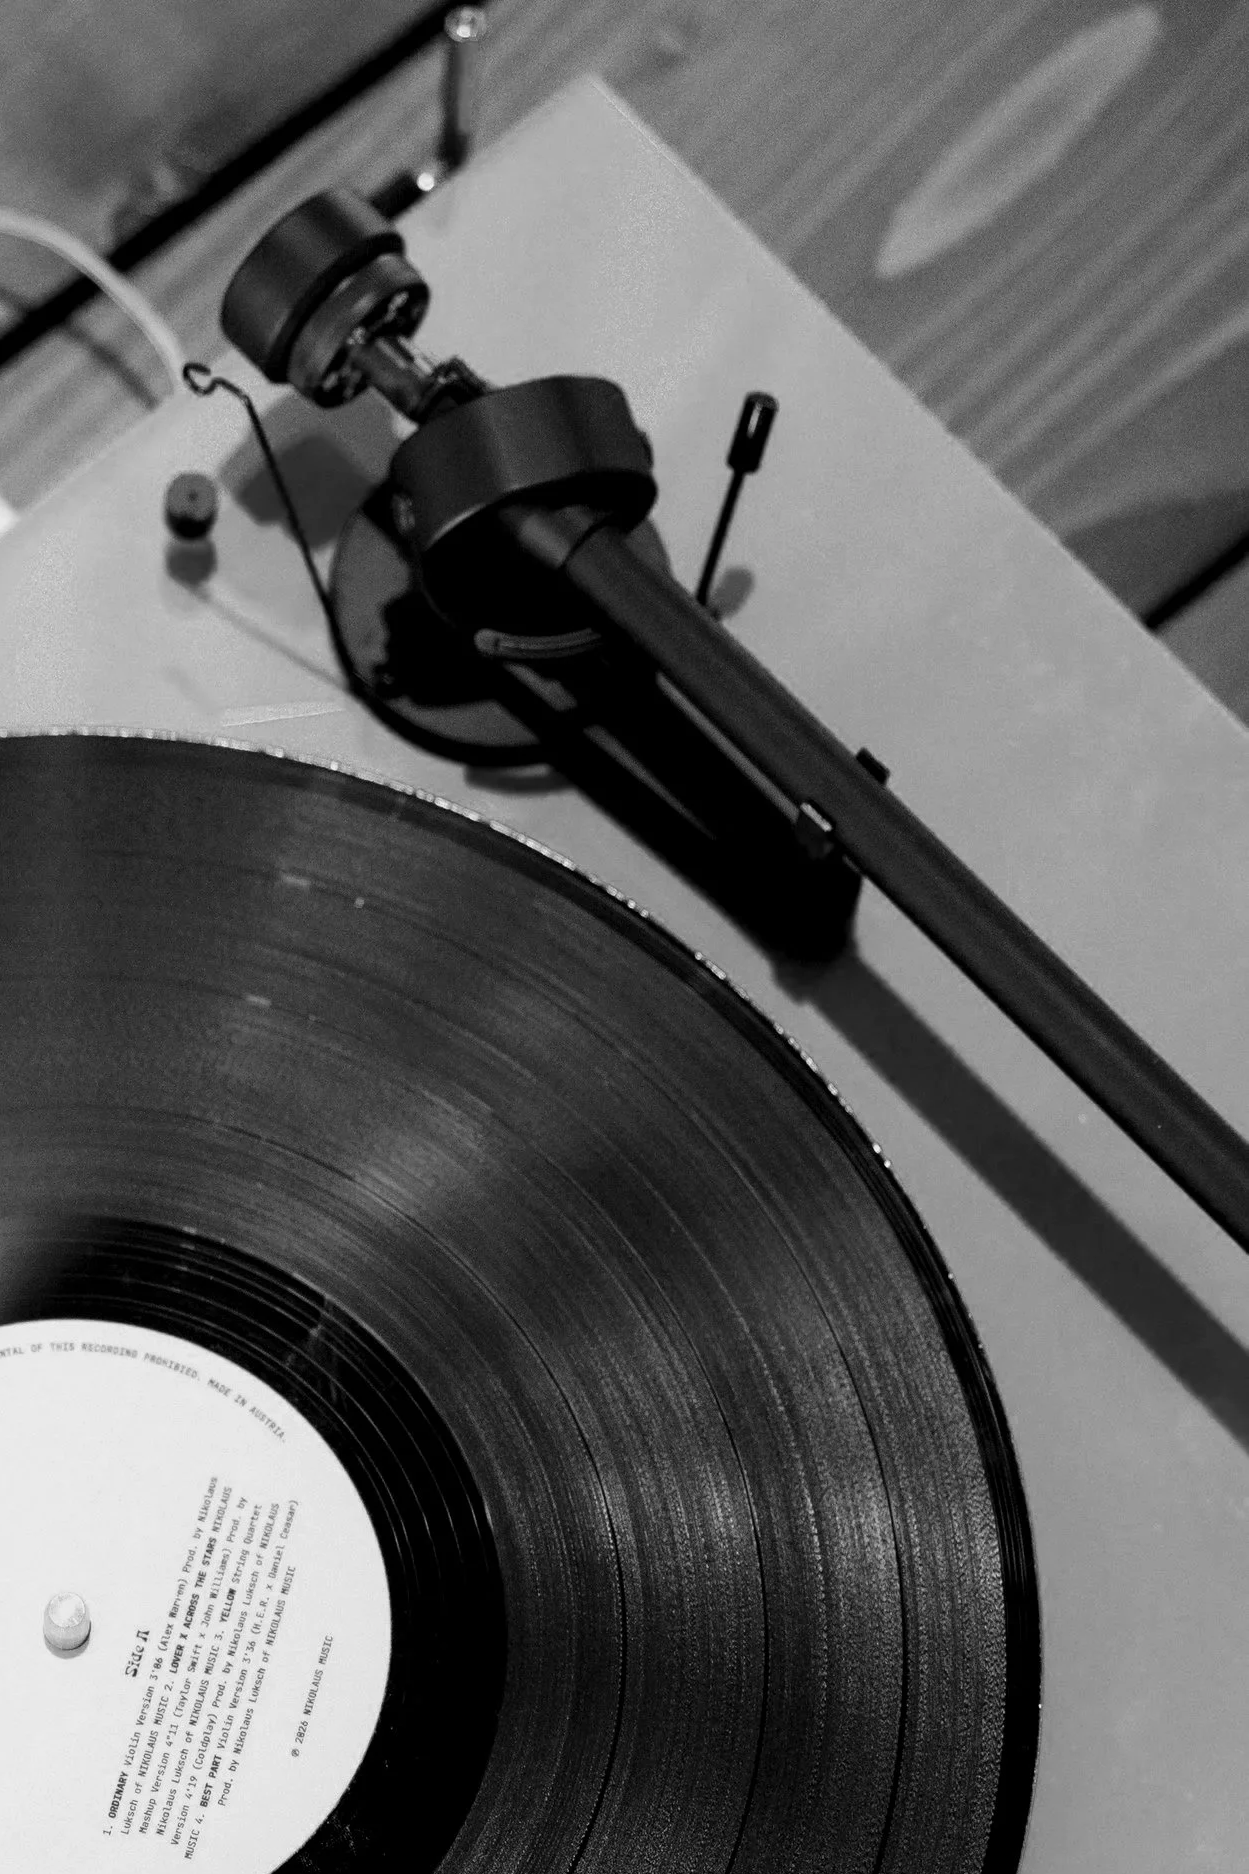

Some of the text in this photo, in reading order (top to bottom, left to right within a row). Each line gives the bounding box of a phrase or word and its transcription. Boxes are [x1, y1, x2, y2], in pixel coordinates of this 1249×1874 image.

[31, 1343, 42, 1353] OF
[50, 1342, 75, 1352] THIS
[81, 1343, 139, 1359] RECORDING
[207, 1378, 232, 1398] MADE
[234, 1394, 248, 1408] IN
[248, 1406, 285, 1443] AUSTRIA.
[197, 1476, 218, 1523] Nikolaus
[236, 1496, 249, 1510] by
[192, 1527, 204, 1540] by
[225, 1515, 242, 1544] Prod.
[258, 1503, 280, 1550] NIKOLAUS
[181, 1546, 198, 1574] Prod.
[209, 1548, 232, 1600] Williams)
[255, 1553, 264, 1567] of
[168, 1578, 188, 1619] Warren)
[242, 1570, 260, 1606] Luksch
[198, 1632, 206, 1640] x
[200, 1603, 215, 1628] John
[226, 1610, 248, 1657] Nikolaus
[124, 1629, 151, 1678] Side A
[157, 1623, 175, 1652] (Alex
[120, 1486, 233, 1836] Luksch of NIKOLAUS MUSIC 2. LOVER X ACROSS THE STARS NIKOLAUS
[155, 1504, 263, 1837] Nikolaus Luksch of NIKOLAUS MUSIC 3. YELLOW String Quartet
[186, 1644, 203, 1673] Swift
[221, 1660, 234, 1675] by
[302, 1668, 324, 1717] NIKOLAUS
[318, 1635, 334, 1666] MUSIC
[172, 1677, 192, 1718] (Taylor
[184, 1499, 299, 1860] MUSIC 4. BEST PART Violin Version 3'36 (H.E.R. x Daniel Ceasar)
[211, 1681, 228, 1709] Prod.
[217, 1565, 297, 1807] Prod. by Nikolaus Luksch of NIKOLAUS MUSIC
[135, 1685, 155, 1726] Version
[123, 1731, 142, 1767] Violin
[192, 1713, 218, 1771] (Coldplay)
[150, 1752, 171, 1793] Version
[107, 1770, 129, 1820] ORDINARY
[102, 1825, 114, 1837] 1.
[138, 1798, 157, 1835] Mashup
[170, 1804, 190, 1846] Version
